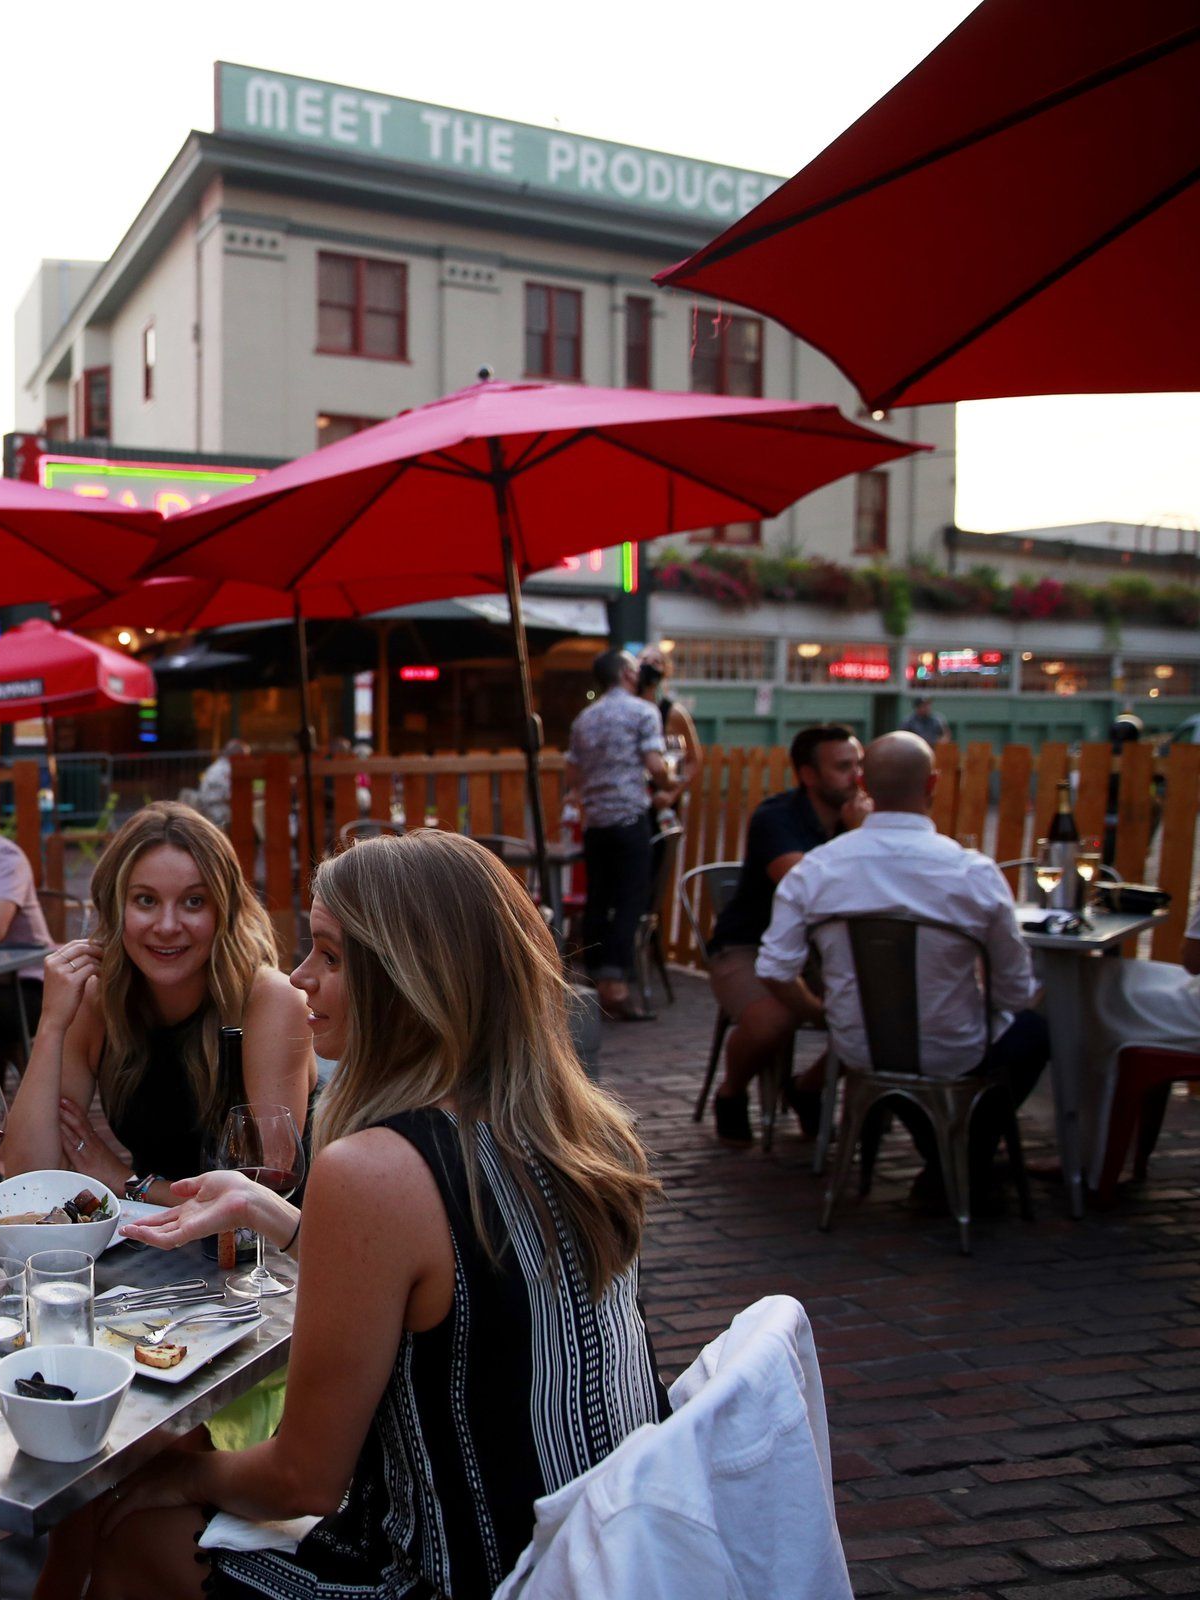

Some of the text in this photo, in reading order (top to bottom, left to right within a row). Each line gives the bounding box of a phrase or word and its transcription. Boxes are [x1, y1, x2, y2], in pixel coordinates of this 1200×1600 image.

[245, 76, 786, 216] MEET THE PRODUCE
